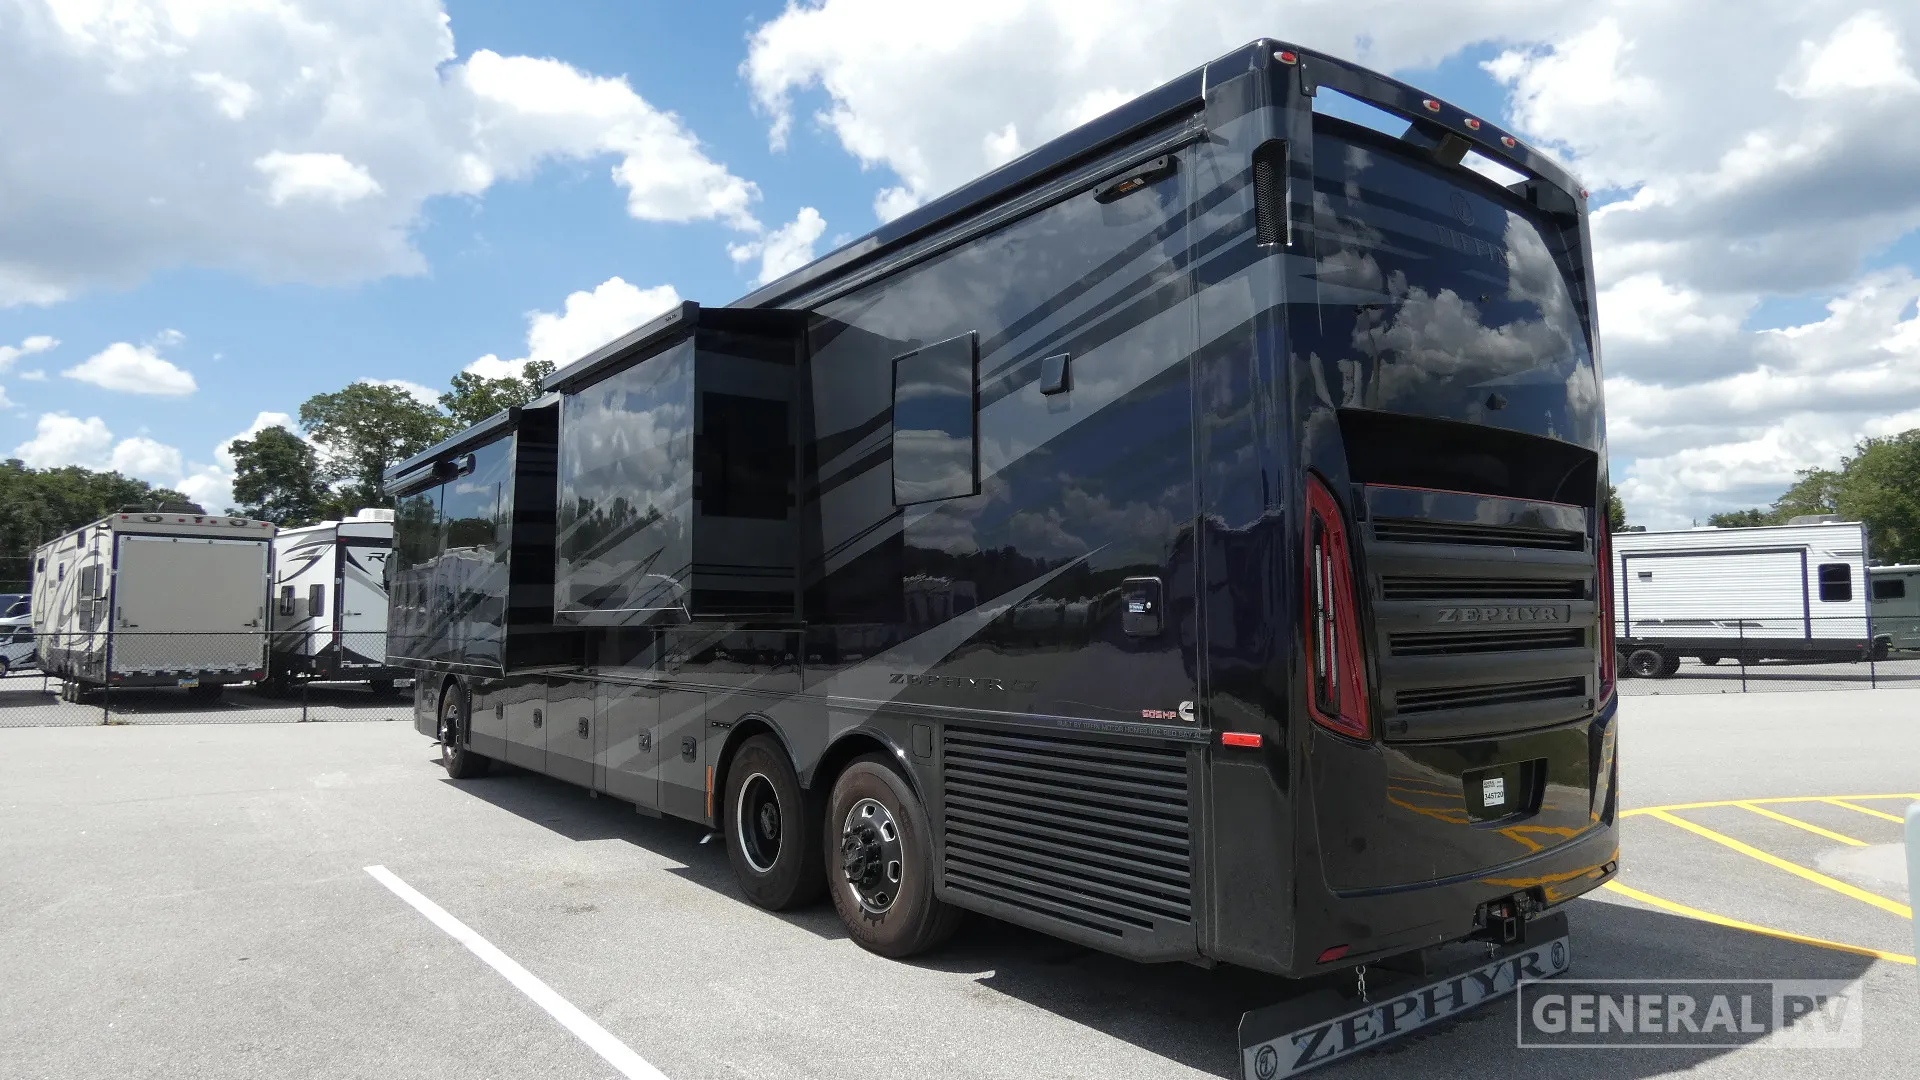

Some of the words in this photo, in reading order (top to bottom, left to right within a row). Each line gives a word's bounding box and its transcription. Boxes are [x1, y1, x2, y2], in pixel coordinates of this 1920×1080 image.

[1437, 606, 1559, 623] ZEPHYR
[888, 673, 1005, 691] ZEPHYR
[1291, 952, 1547, 1070] ZEPHYR
